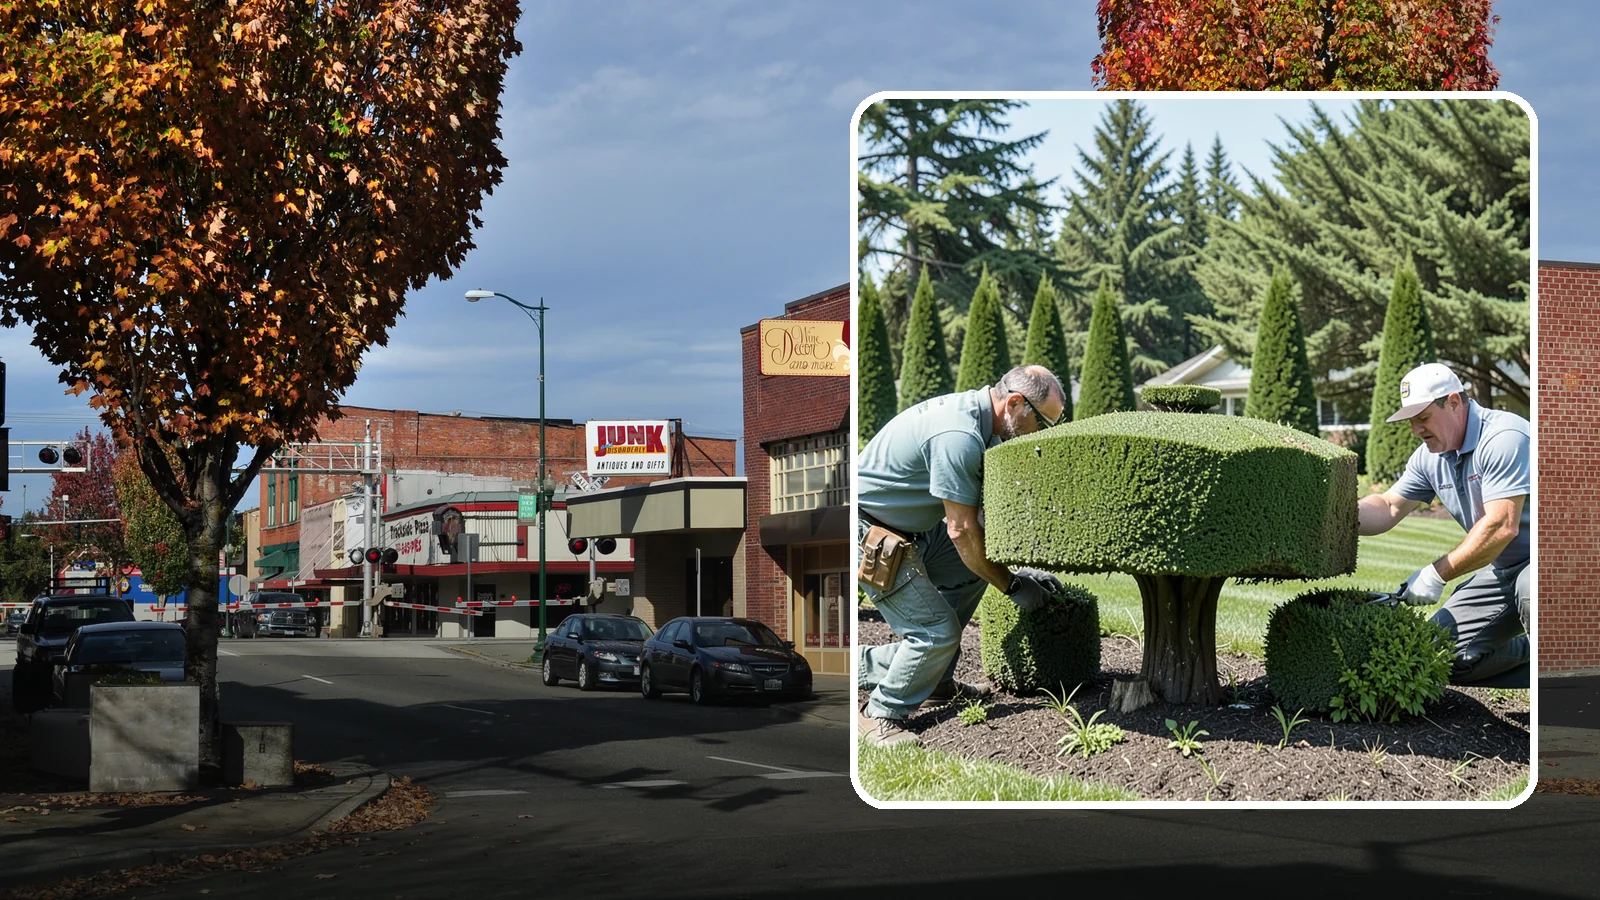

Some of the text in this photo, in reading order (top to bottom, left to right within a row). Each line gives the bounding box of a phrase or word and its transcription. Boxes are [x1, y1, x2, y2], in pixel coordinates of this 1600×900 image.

[596, 425, 665, 457] JUNK
[607, 446, 646, 454] DISORDERLY
[597, 461, 665, 470] ANTIQUES AND GIFTS
[414, 519, 429, 535] Pizza
